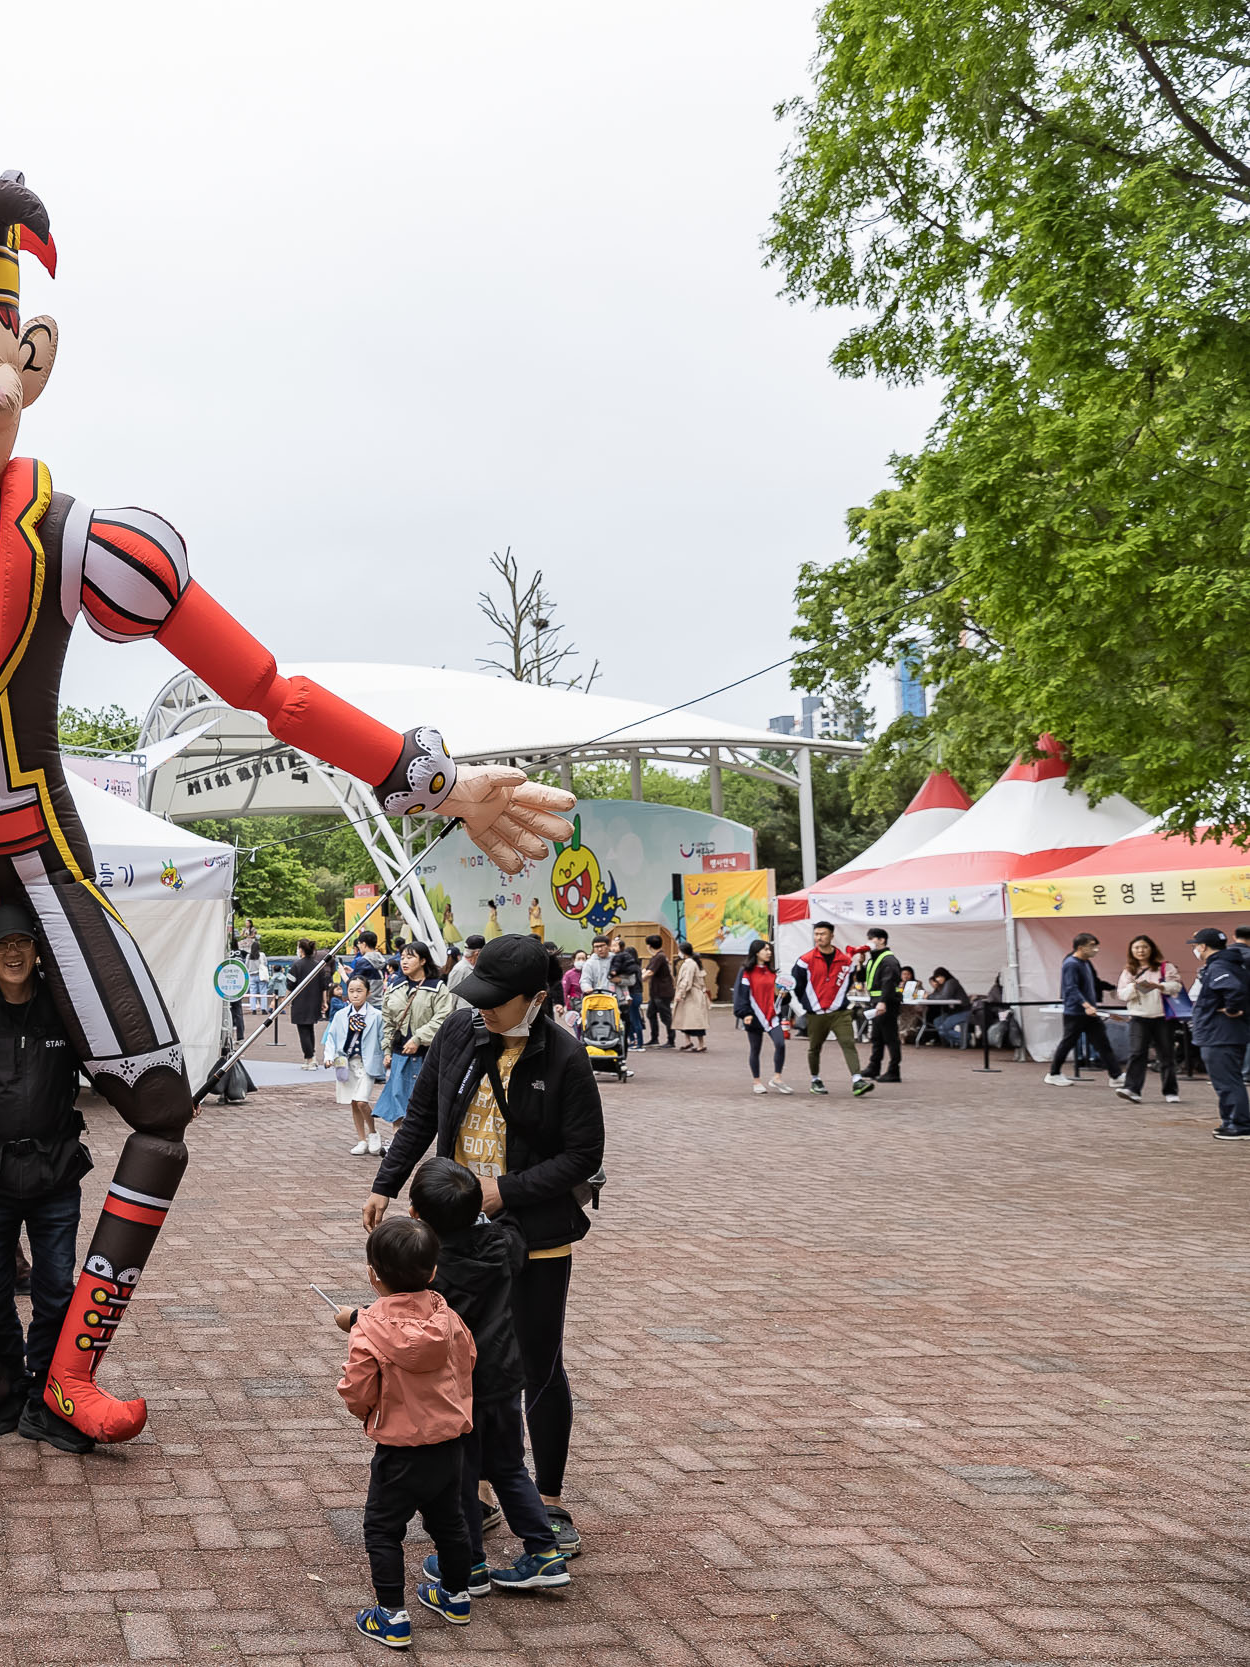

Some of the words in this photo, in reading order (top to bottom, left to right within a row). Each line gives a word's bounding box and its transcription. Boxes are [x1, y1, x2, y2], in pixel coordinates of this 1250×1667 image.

[1093, 880, 1197, 905] 운영본부
[866, 897, 929, 917] 종합상황실
[463, 1135, 504, 1158] BOYS
